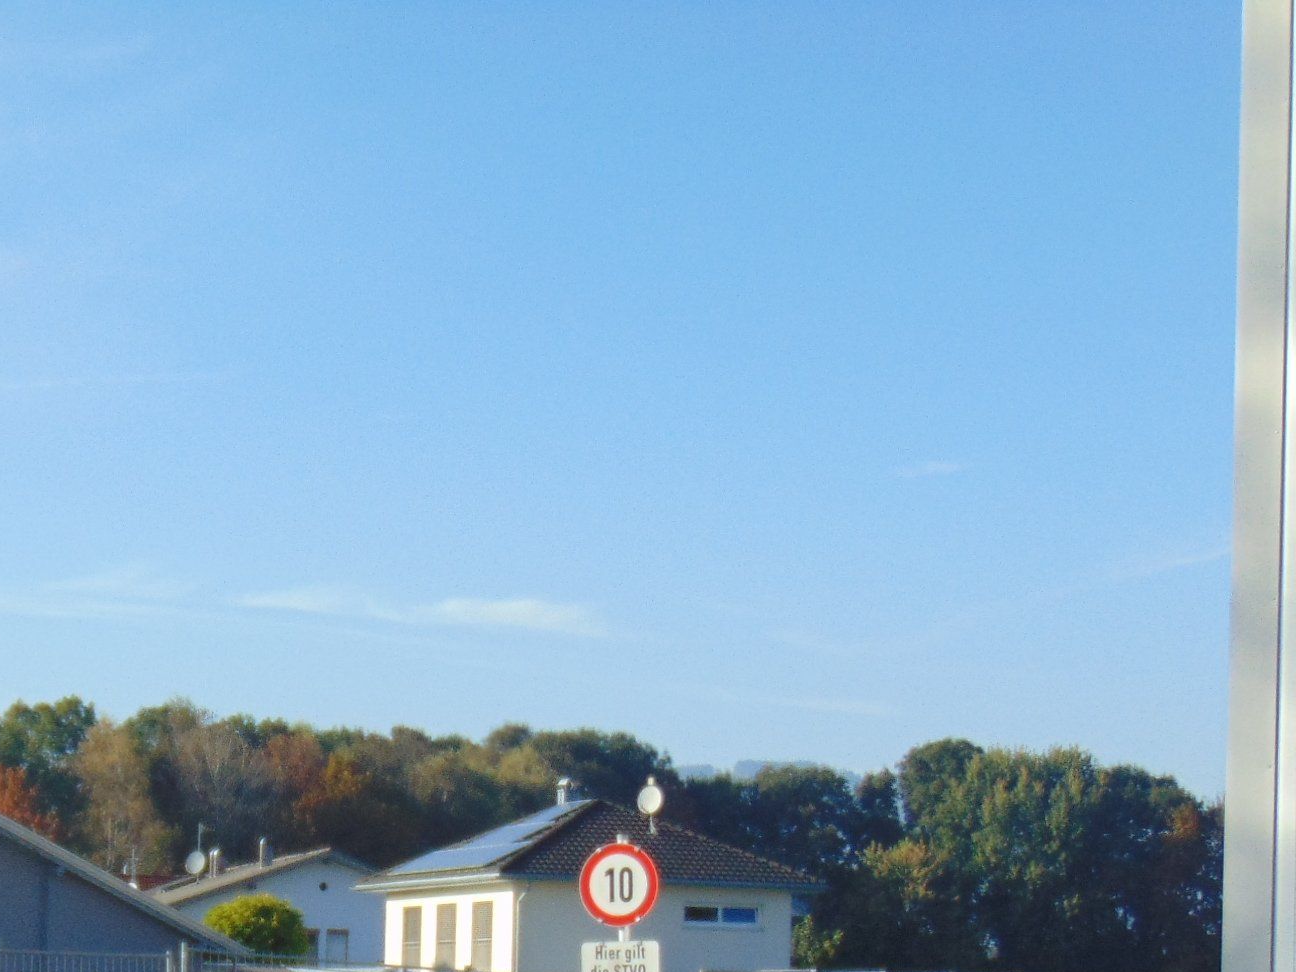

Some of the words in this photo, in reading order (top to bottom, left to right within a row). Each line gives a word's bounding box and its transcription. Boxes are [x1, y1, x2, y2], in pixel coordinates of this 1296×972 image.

[604, 866, 634, 903] 10
[595, 945, 621, 960] Hier
[624, 944, 646, 963] gilt
